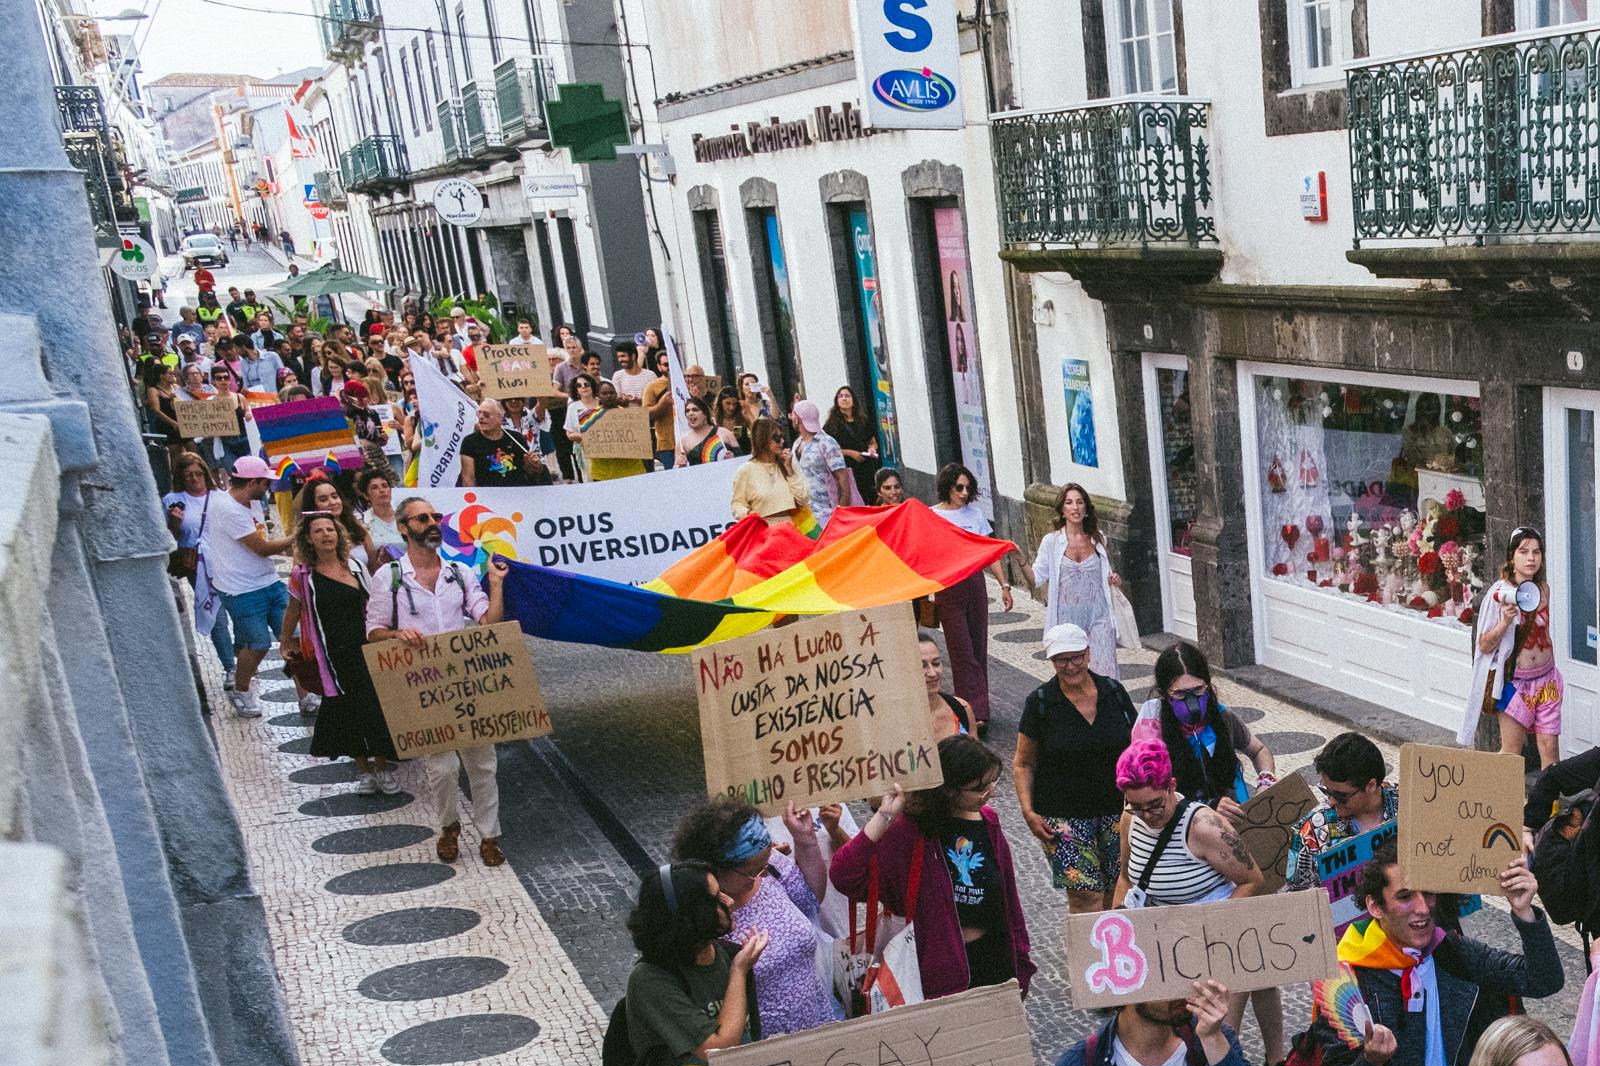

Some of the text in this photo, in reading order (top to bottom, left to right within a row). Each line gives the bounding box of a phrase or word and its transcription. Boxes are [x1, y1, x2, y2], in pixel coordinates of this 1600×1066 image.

[889, 79, 940, 99] AVLIS
[747, 116, 807, 154] Pacheco
[310, 206, 330, 215] STOP
[481, 346, 531, 360] Protect
[180, 400, 209, 413] AMOR
[534, 511, 614, 539] OPUS
[377, 629, 499, 673] NÃO HÁ CURA
[699, 652, 744, 694] NÃO
[859, 614, 881, 647] À
[404, 667, 444, 689] PARA
[446, 662, 458, 677] A
[731, 652, 885, 717] CUSTA DA NOSSA
[455, 699, 479, 720] SÓ
[397, 724, 456, 752] ORGULHO
[770, 725, 844, 765] SOMOS
[793, 766, 803, 785] E
[1458, 800, 1497, 821] are
[1415, 834, 1456, 857] not
[1321, 845, 1358, 875] THE
[1459, 852, 1501, 883] alone
[1084, 912, 1298, 996] Bichas
